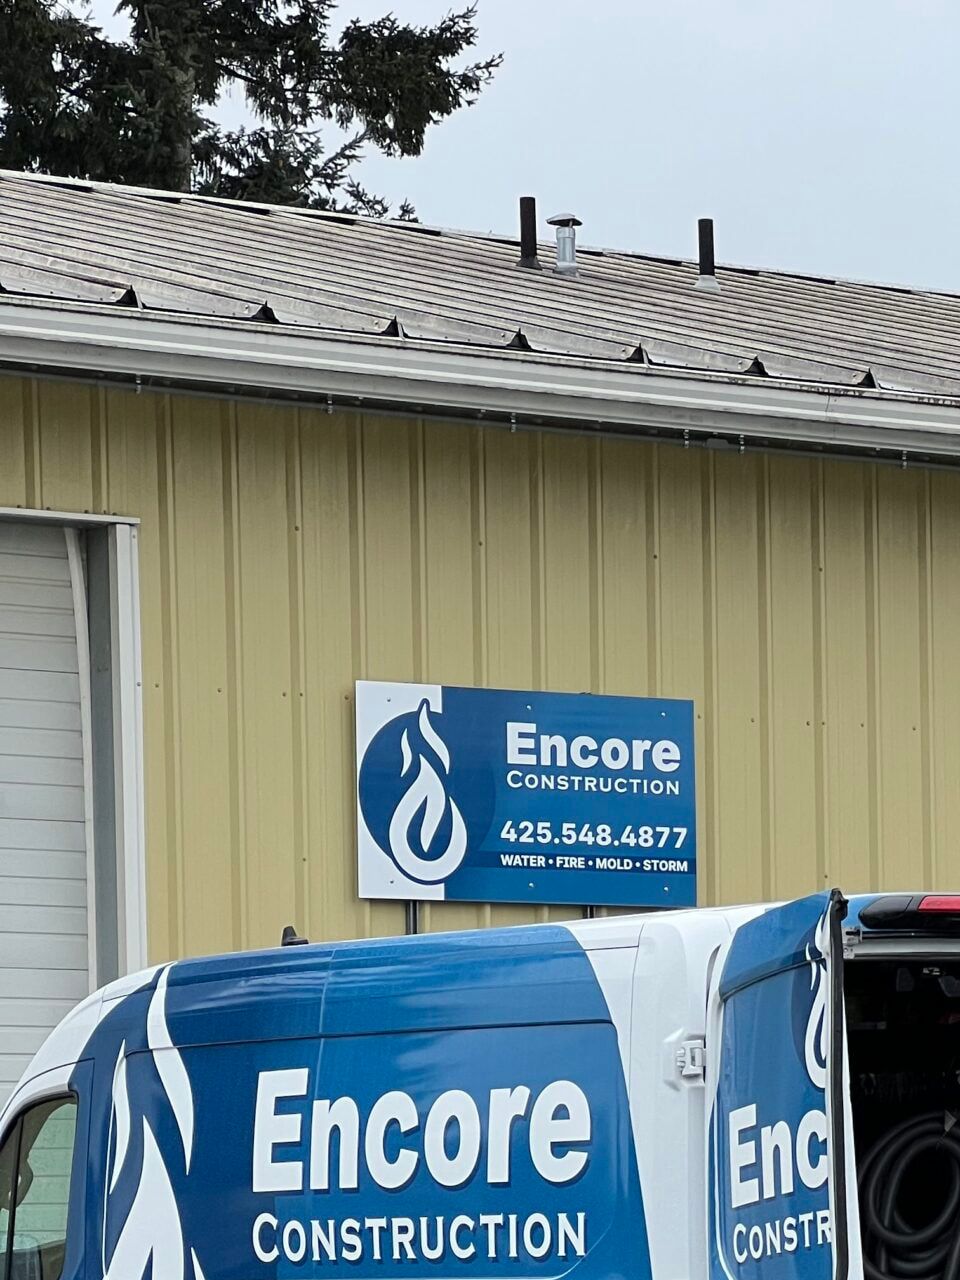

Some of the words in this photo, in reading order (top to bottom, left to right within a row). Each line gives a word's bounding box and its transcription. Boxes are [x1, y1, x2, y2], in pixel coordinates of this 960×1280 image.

[506, 722, 681, 772] Encore
[506, 770, 680, 795] CONSTRUCTION
[500, 821, 688, 849] 425.548.4877
[500, 854, 546, 868] WATER
[556, 857, 586, 870] FIRE
[595, 858, 633, 871] MOLD
[643, 860, 688, 872] STORM
[252, 1068, 592, 1193] Encore
[252, 1212, 587, 1264] CONSTRUCTION
